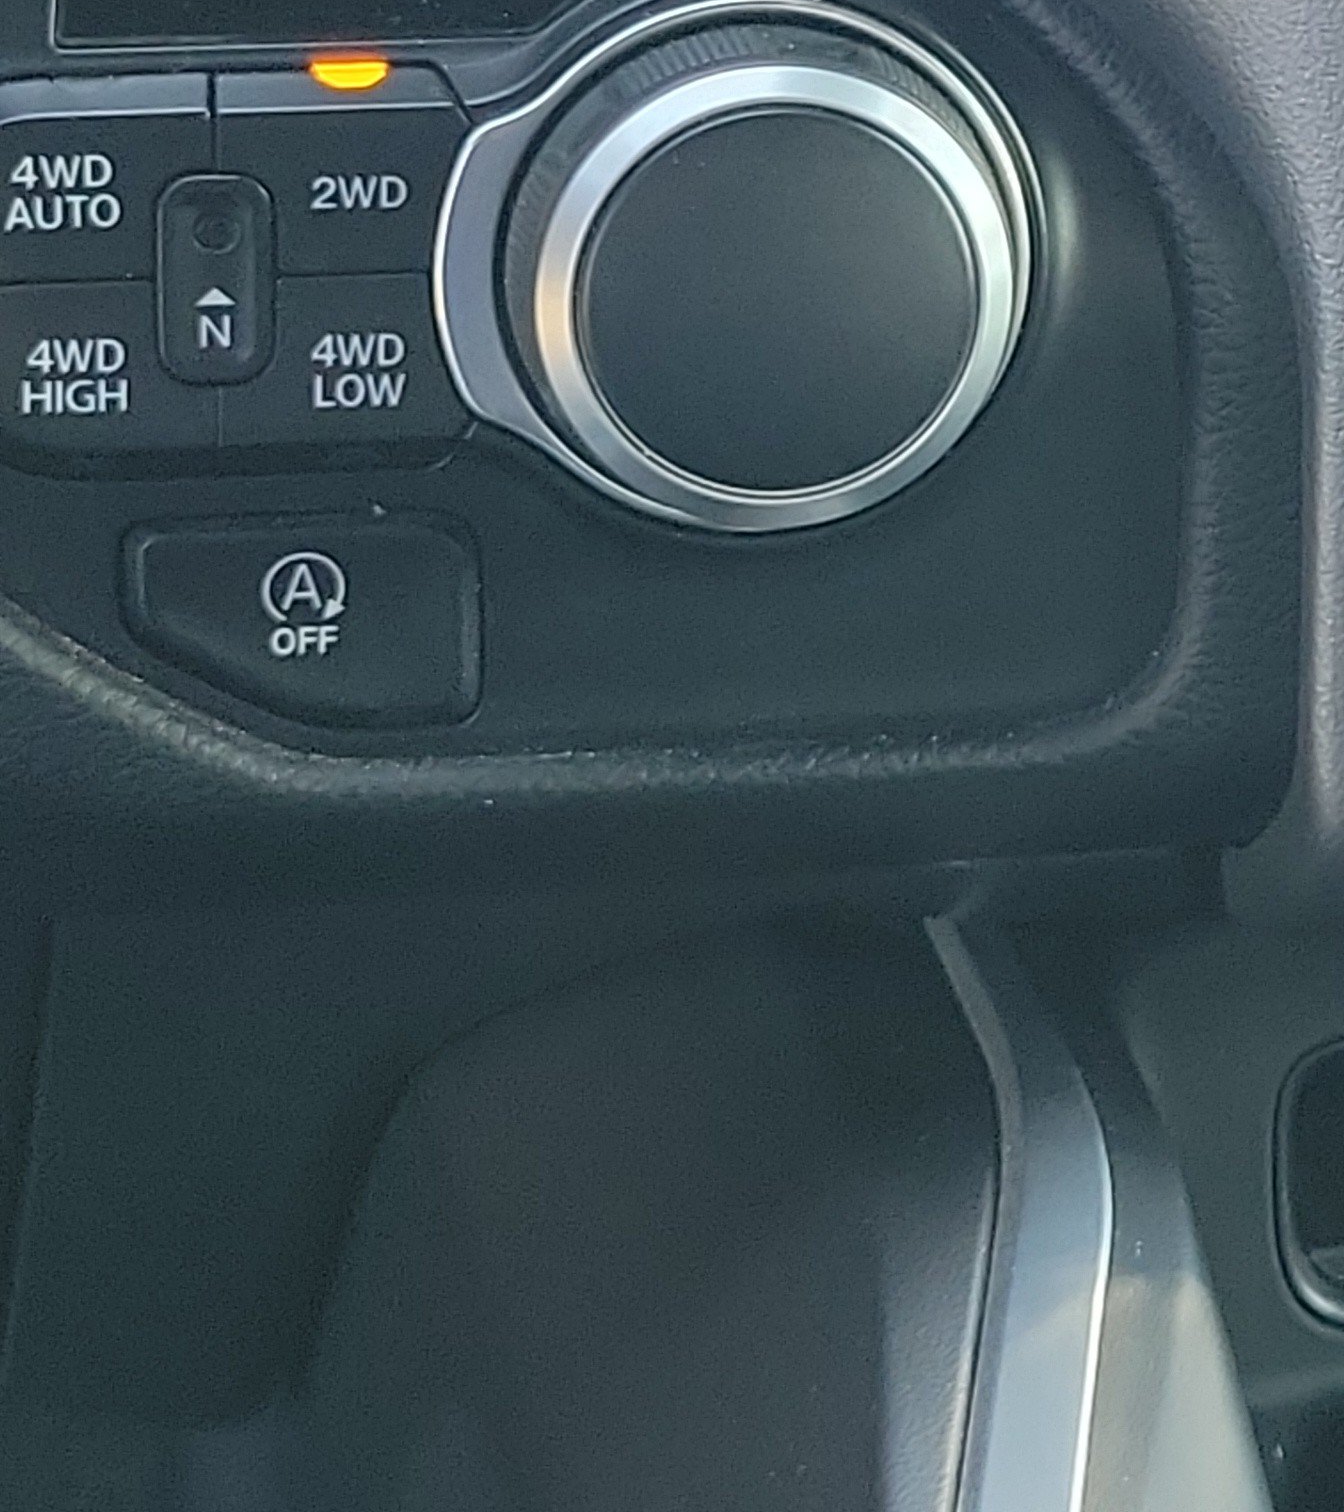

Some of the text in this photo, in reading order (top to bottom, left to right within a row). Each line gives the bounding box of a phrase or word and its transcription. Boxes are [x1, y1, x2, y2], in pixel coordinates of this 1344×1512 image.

[10, 153, 115, 192] 4WD
[4, 191, 122, 231] AUTO
[310, 175, 408, 211] 2WD
[198, 314, 234, 350] N
[310, 332, 406, 370] 4WD
[26, 337, 127, 375] 4WD
[20, 377, 130, 416] HIGH
[312, 371, 406, 409] LOW
[270, 624, 340, 657] OFF
